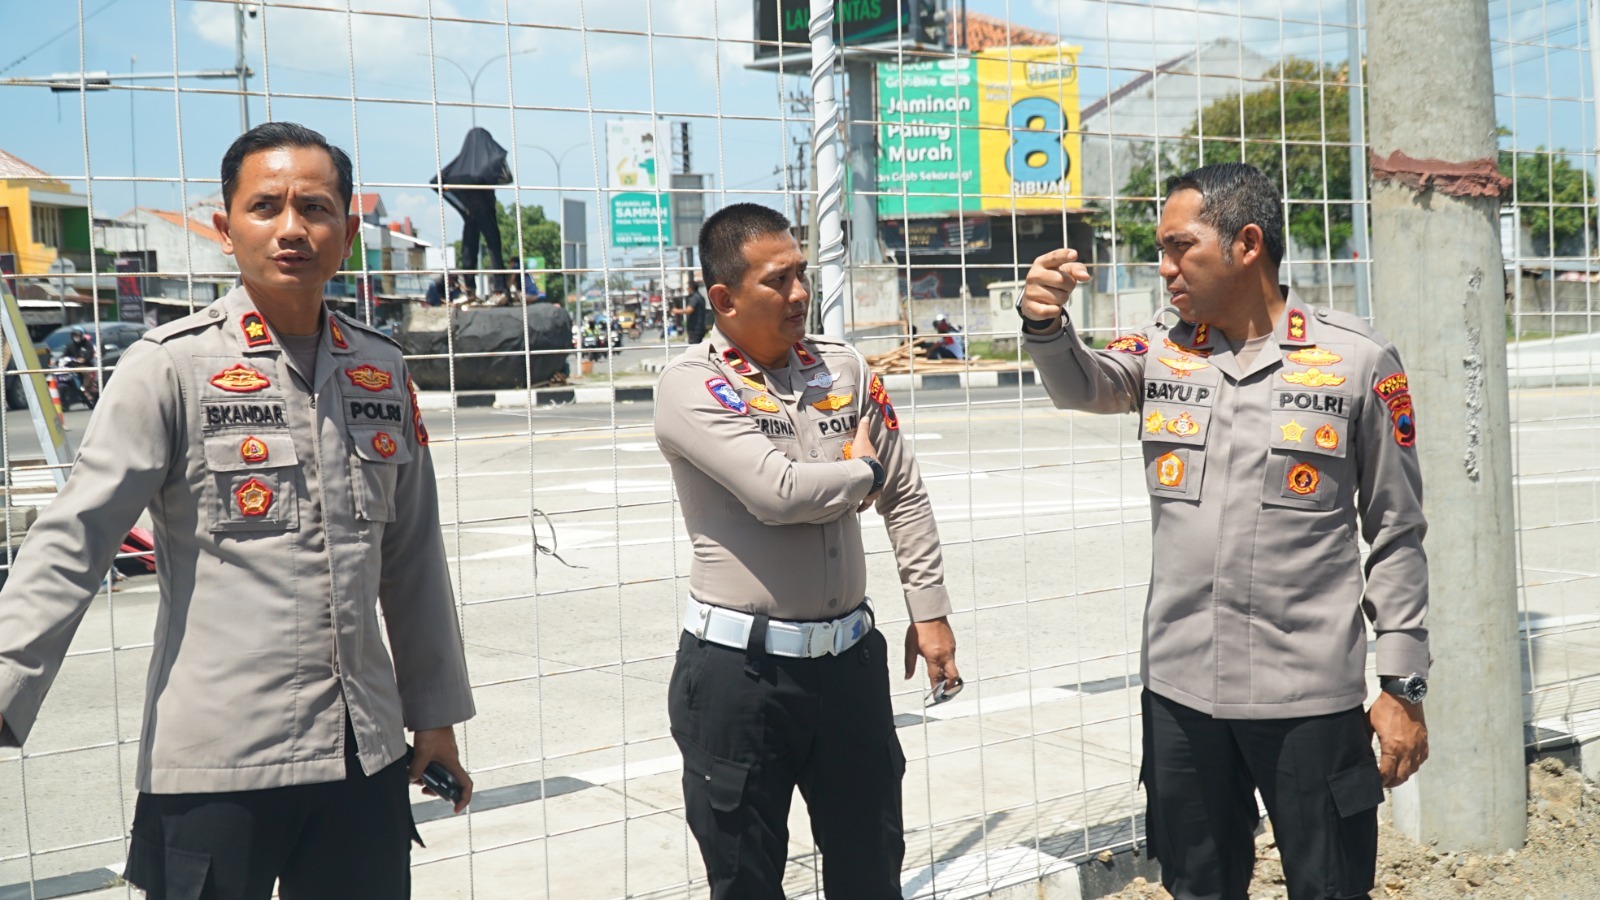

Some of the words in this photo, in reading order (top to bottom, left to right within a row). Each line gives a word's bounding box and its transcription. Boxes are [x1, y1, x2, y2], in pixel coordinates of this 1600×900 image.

[887, 94, 971, 114] Jaminan
[888, 119, 951, 141] Paling
[1004, 96, 1071, 183] 8
[889, 142, 954, 162] Murah
[1010, 180, 1071, 196] RIBUAN
[615, 207, 668, 218] SAMPAH
[1147, 382, 1193, 402] BAYU
[1195, 387, 1210, 403] P
[350, 401, 402, 422] POLRI
[1279, 392, 1344, 414] POLRI
[206, 405, 285, 425] ISKANDAR
